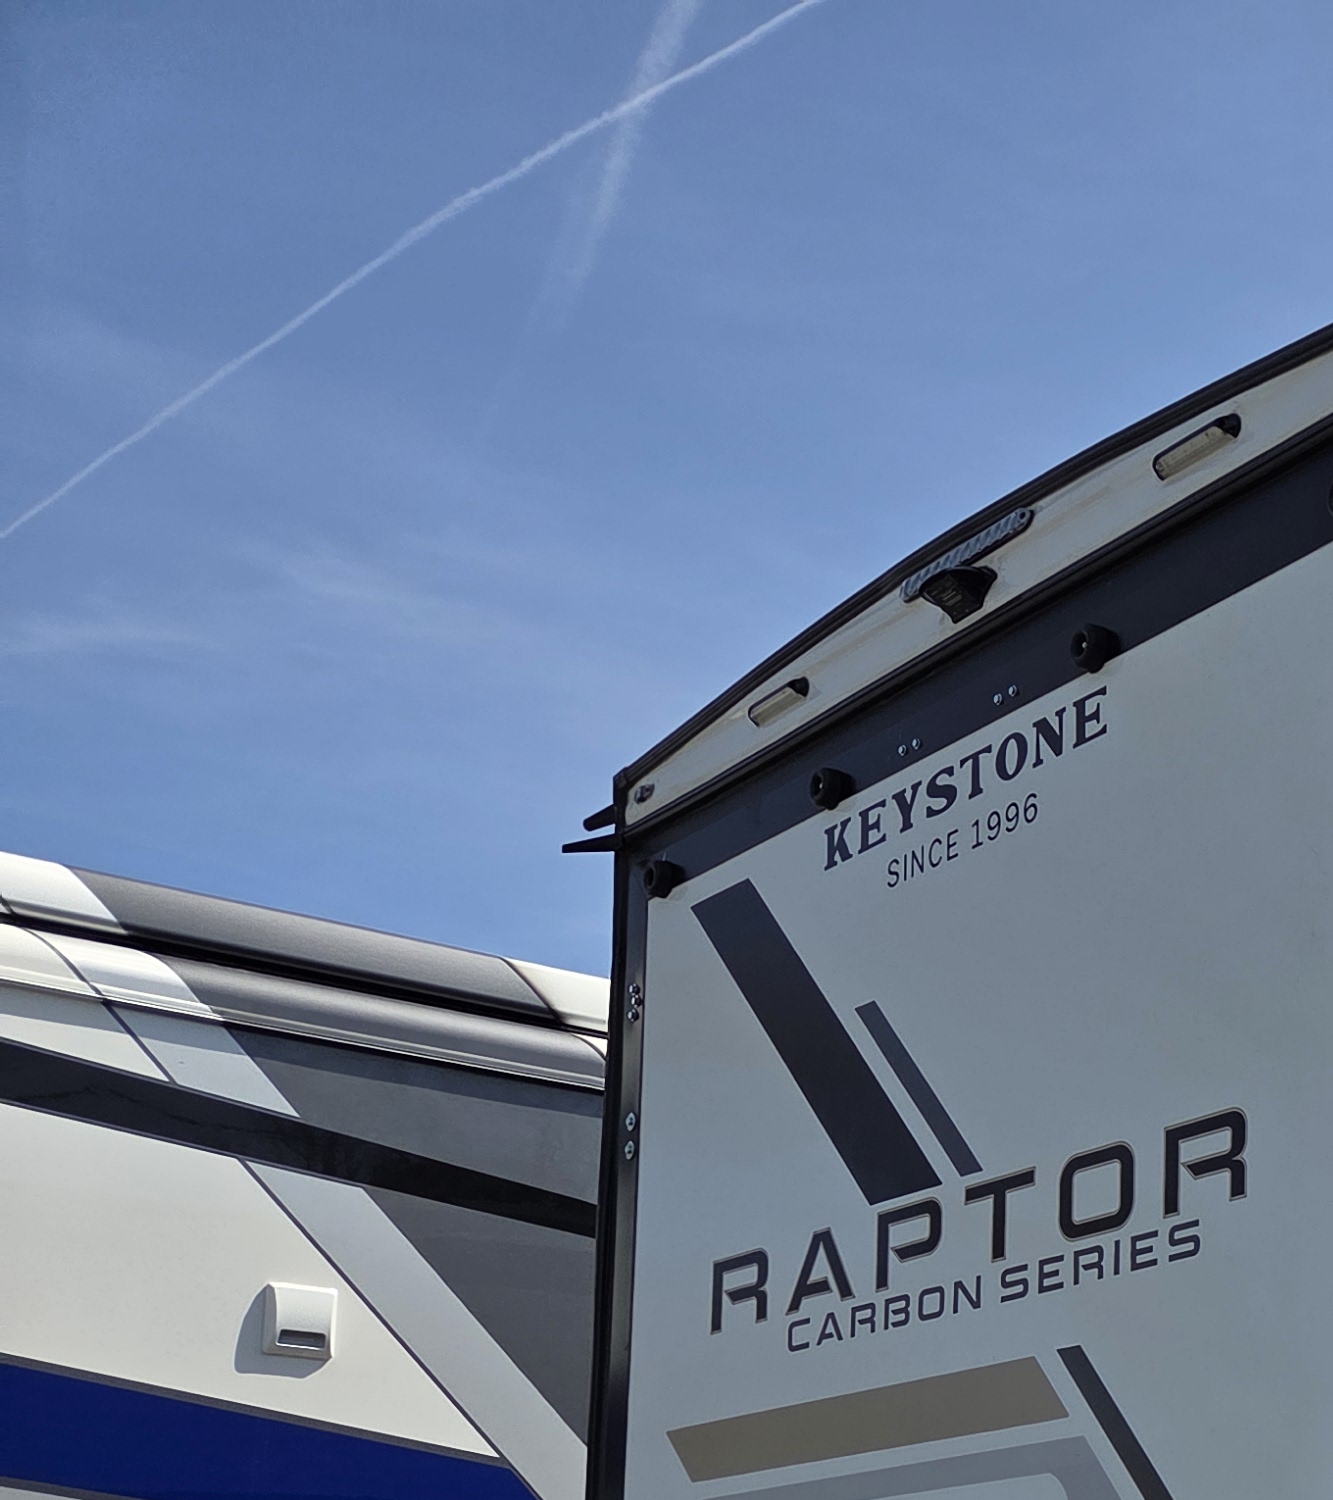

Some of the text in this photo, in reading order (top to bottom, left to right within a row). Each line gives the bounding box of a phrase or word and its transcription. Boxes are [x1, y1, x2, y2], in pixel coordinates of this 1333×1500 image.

[823, 686, 1109, 871] KEYSTONE
[886, 791, 1040, 889] SINCE 1996
[709, 1105, 1248, 1335] RAPTOR
[786, 1218, 1202, 1353] CARBON SERIES
